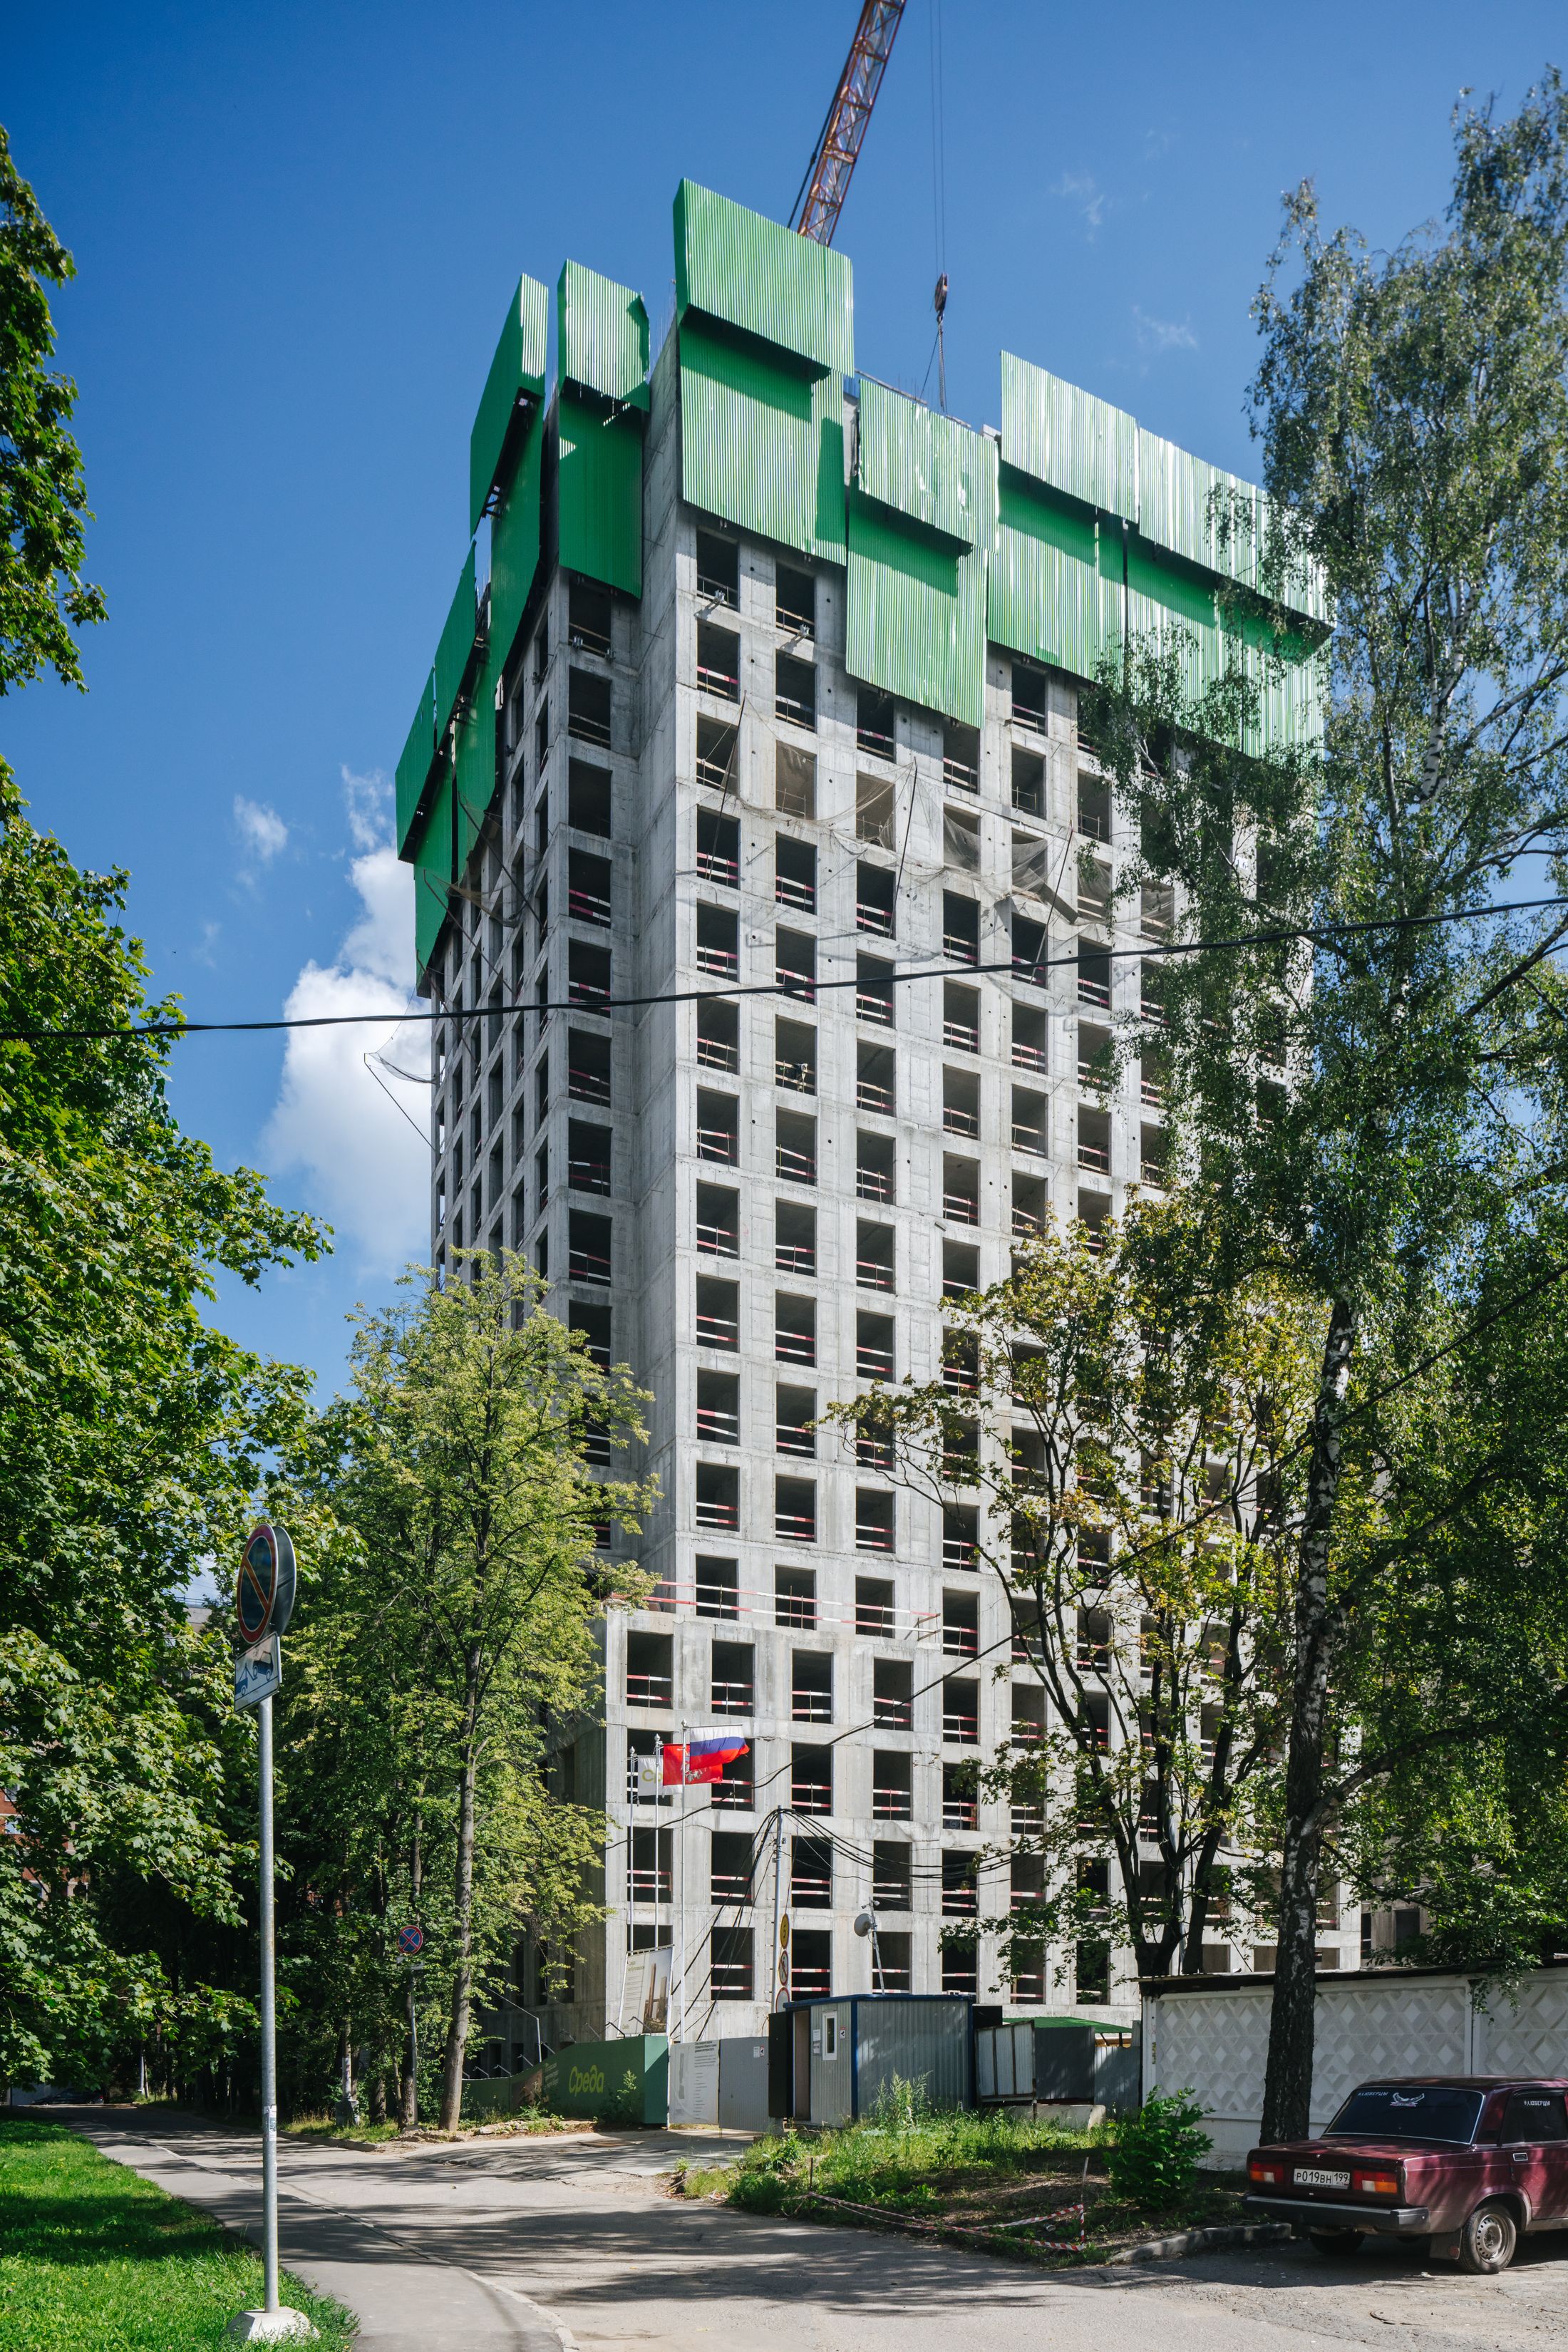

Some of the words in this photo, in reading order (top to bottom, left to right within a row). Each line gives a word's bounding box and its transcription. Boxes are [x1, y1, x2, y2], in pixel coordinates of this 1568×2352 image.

[569, 2065, 604, 2097] Среда
[1296, 2171, 1331, 2184] Р019ВН
[1334, 2172, 1348, 2182] 199
